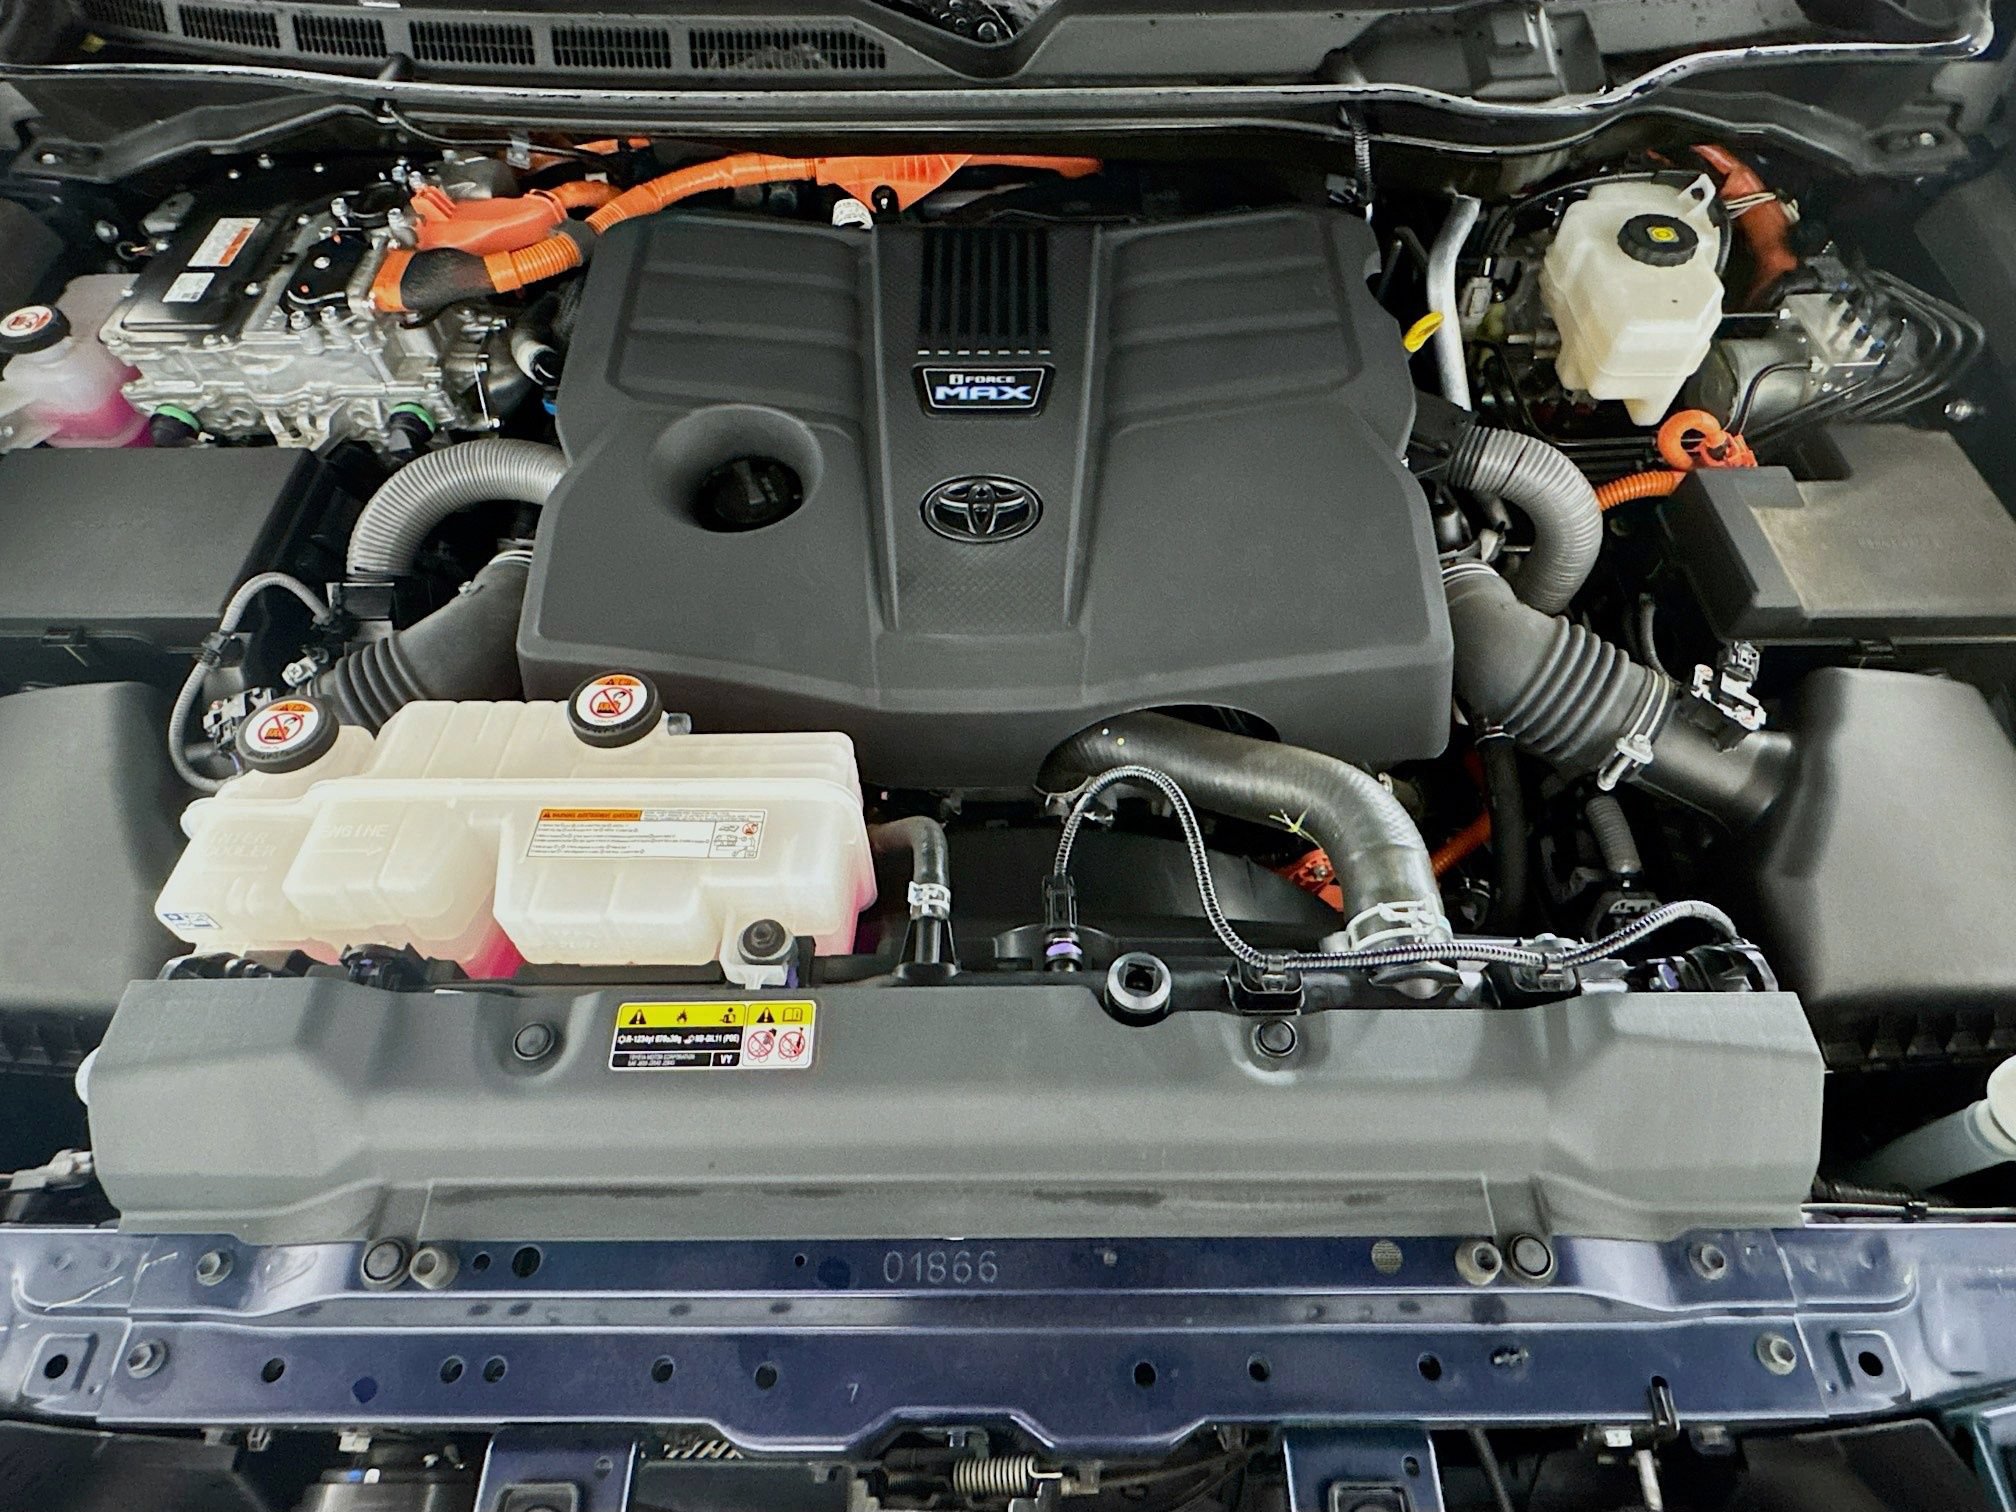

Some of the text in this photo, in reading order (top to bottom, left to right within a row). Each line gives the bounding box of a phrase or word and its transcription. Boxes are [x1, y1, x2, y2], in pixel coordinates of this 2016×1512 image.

[935, 386, 1032, 400] MAX
[320, 823, 390, 838] ENGINE
[210, 831, 270, 844] INTER
[206, 844, 277, 857] COOLER
[720, 1054, 733, 1065] VY
[883, 1250, 998, 1284] 01866
